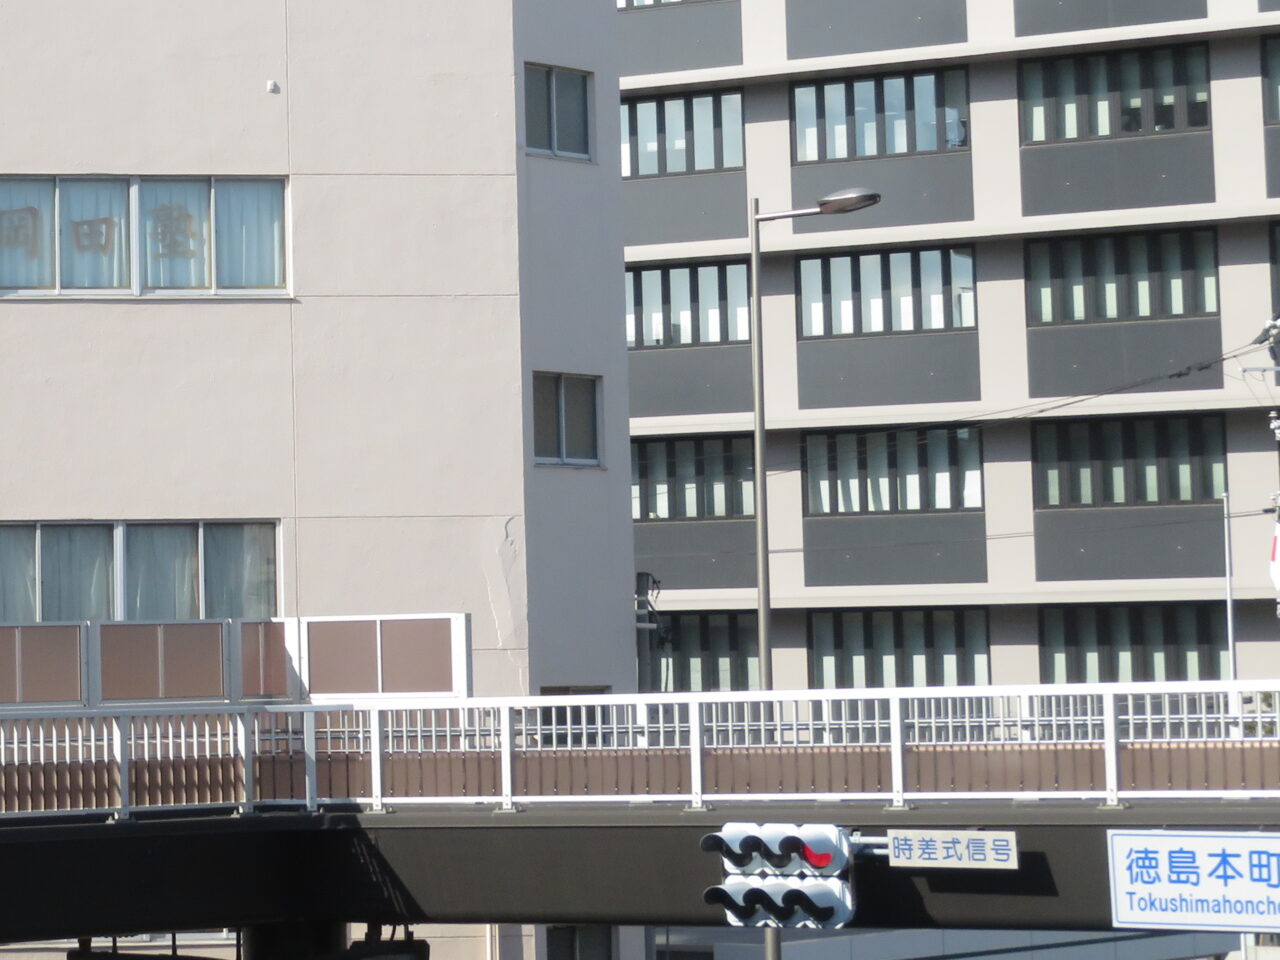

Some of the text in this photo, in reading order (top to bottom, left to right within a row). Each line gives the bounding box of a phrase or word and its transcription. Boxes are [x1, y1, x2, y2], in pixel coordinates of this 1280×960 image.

[892, 836, 1012, 862] 時差式信号
[1126, 848, 1280, 888] 徳島本町
[1126, 891, 1280, 916] Tokushimahonch
